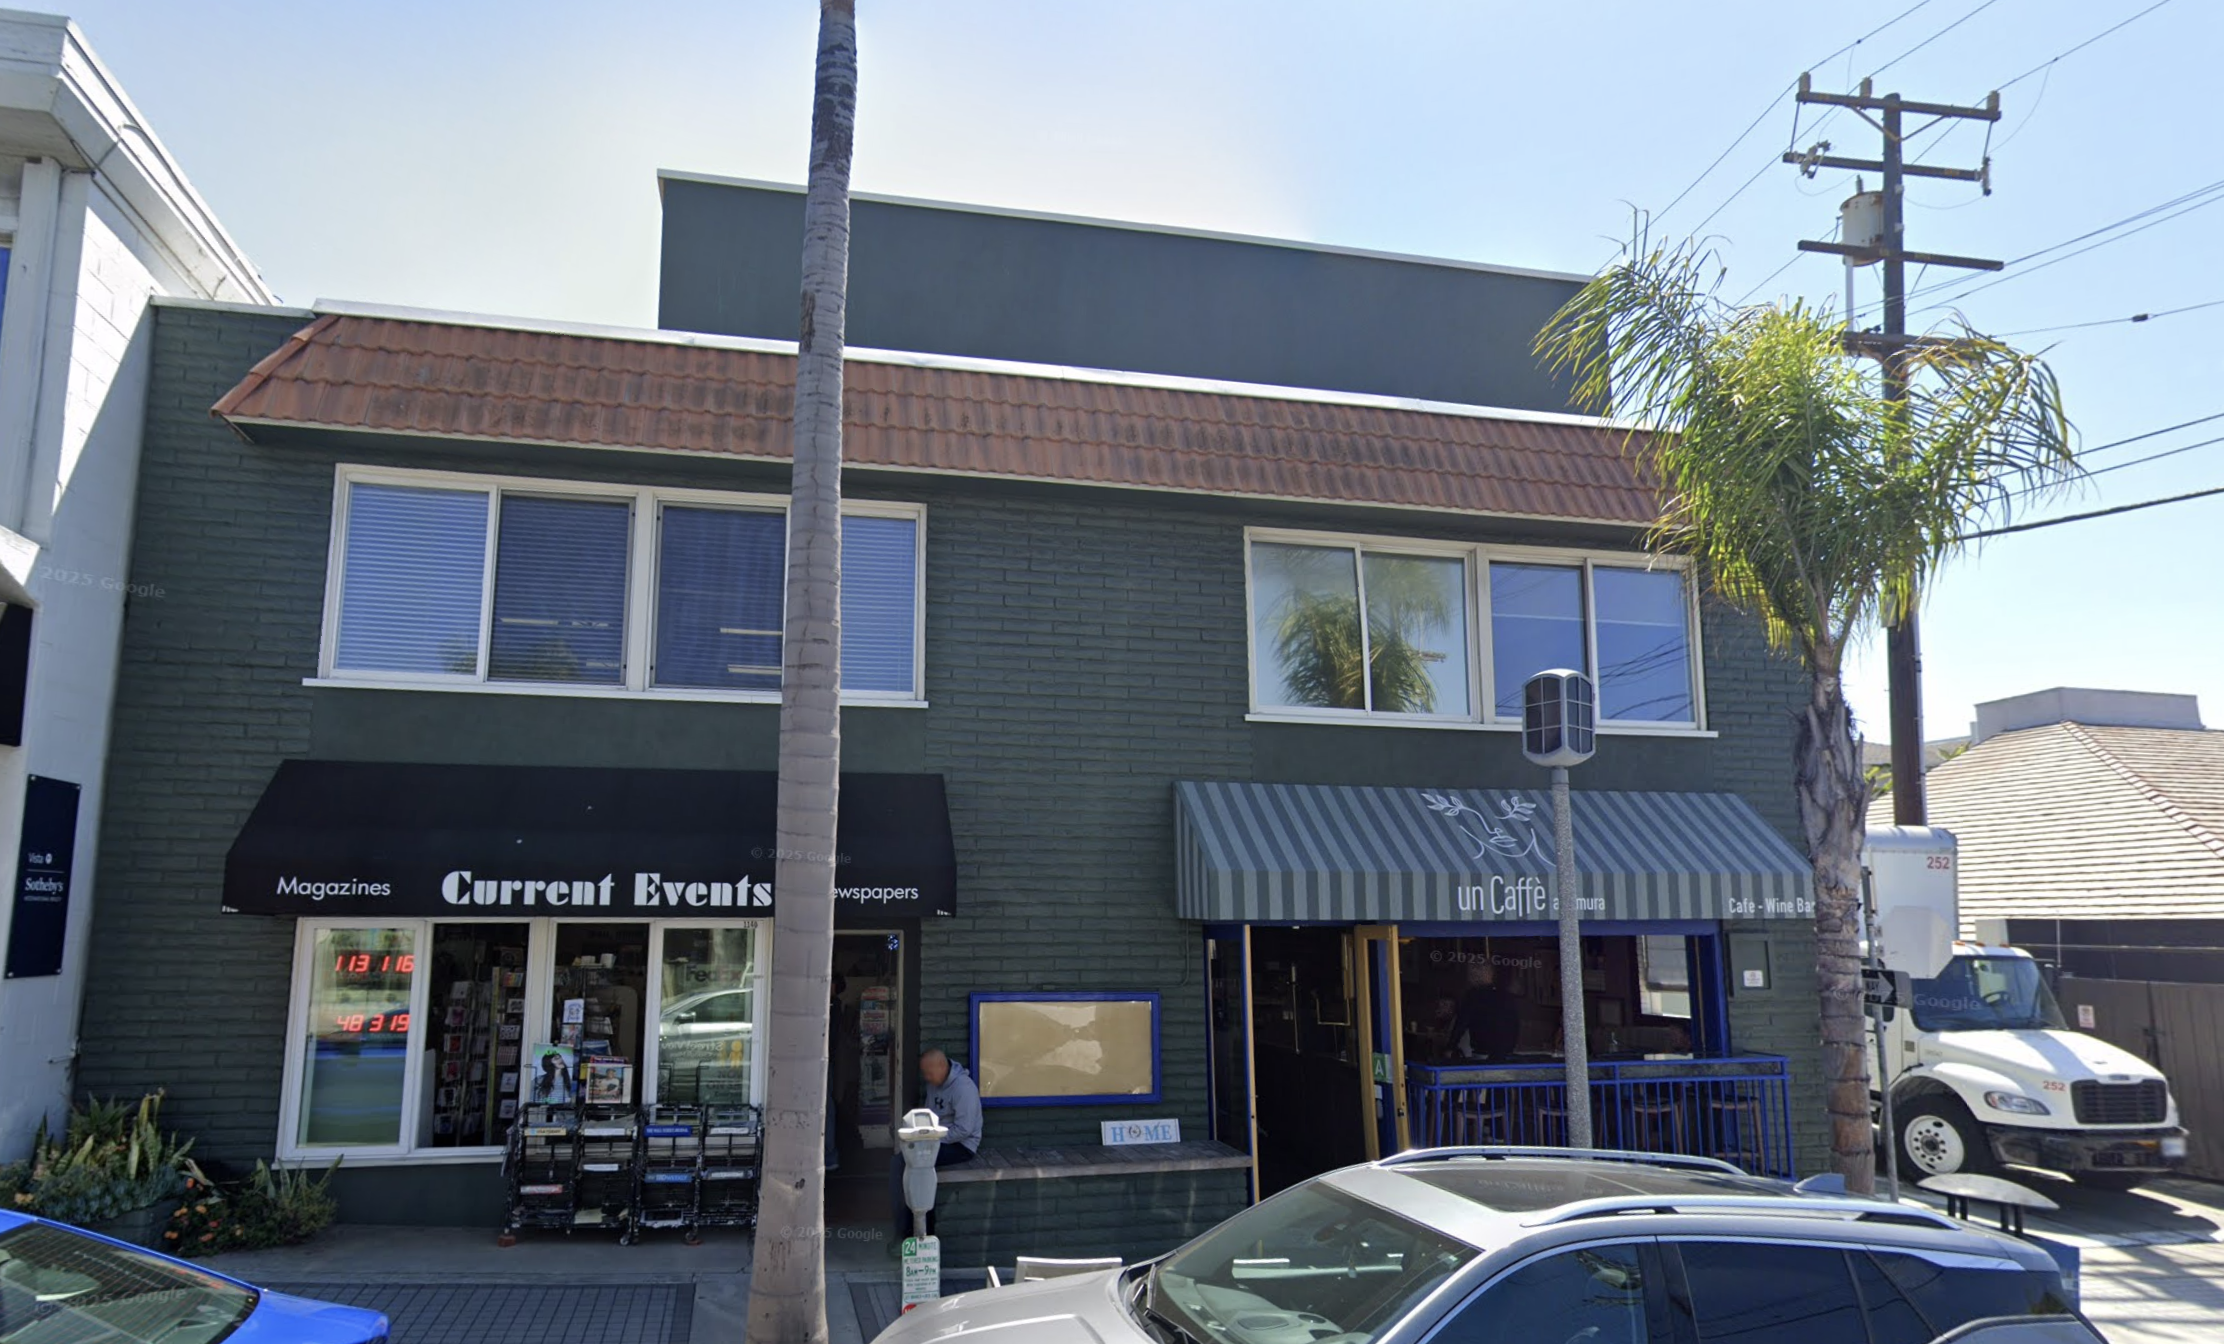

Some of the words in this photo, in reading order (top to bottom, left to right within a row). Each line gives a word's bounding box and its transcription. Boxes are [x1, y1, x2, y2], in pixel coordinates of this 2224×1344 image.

[1926, 856, 1950, 870] 252
[276, 876, 392, 901] Magazines
[441, 870, 616, 906] Current
[633, 872, 774, 907] Events
[831, 886, 919, 904] ewspapers
[1457, 886, 1485, 911] un
[1490, 875, 1546, 918] Caffè
[1553, 896, 1606, 911] amura
[1728, 897, 1756, 914] Cafe
[1764, 897, 1794, 914] Wine
[1374, 1059, 1385, 1077] A
[2043, 1080, 2066, 1092] 252
[904, 1241, 916, 1254] 24
